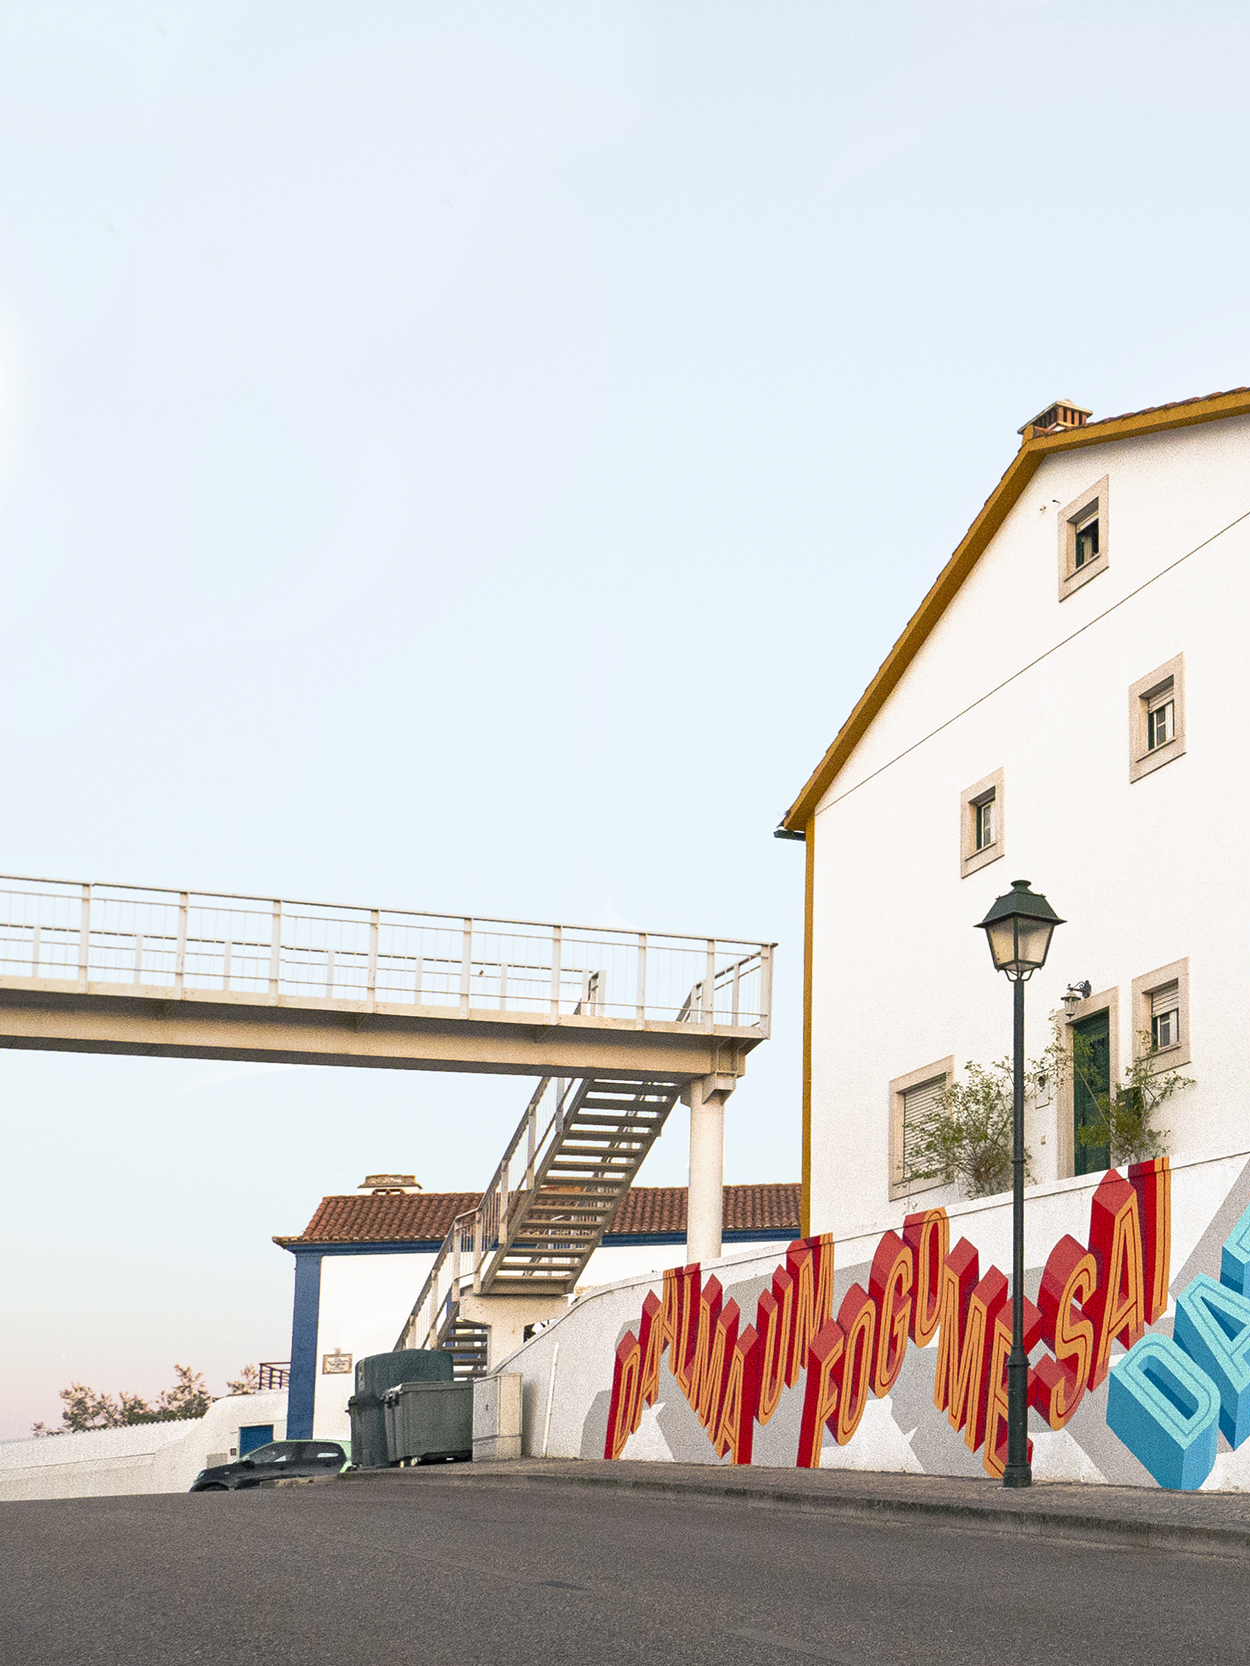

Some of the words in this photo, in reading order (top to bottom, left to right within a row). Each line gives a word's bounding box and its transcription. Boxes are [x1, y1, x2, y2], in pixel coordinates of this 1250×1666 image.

[604, 1289, 662, 1460] DA
[663, 1262, 759, 1465] ALMA
[756, 1232, 834, 1426] UM
[797, 1207, 950, 1468] FOGO
[1038, 1156, 1171, 1431] SAI
